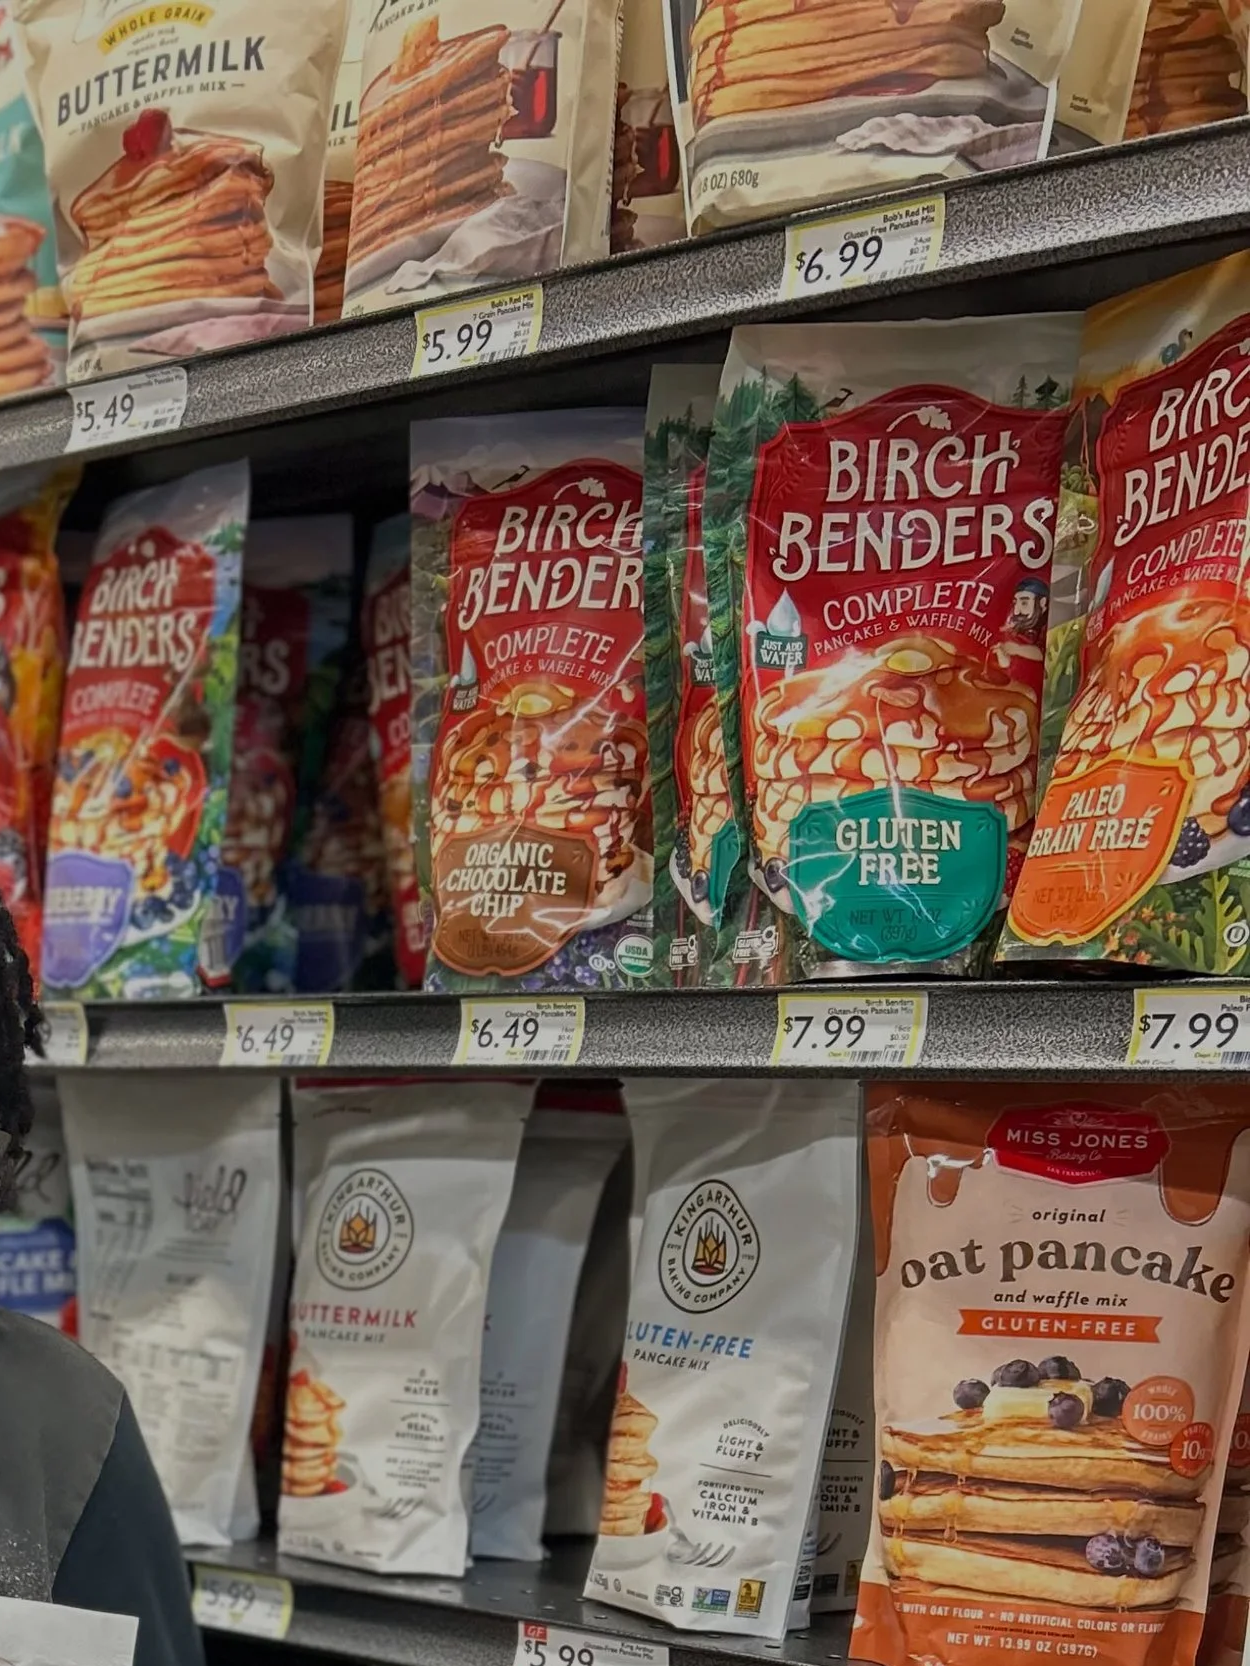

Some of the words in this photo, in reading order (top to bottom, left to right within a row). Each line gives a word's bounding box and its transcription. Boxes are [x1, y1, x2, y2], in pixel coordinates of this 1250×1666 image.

[104, 10, 156, 46] WHOLE
[164, 6, 205, 22] GRAIN
[57, 36, 266, 127] BUTTERMILK
[870, 225, 886, 235] Free
[920, 215, 934, 225] Mix
[883, 211, 901, 223] Bob's
[905, 208, 919, 218] Red
[795, 236, 883, 284] $6.99
[422, 320, 493, 363] $5.99
[76, 393, 134, 432] $5.49
[1150, 369, 1250, 452] BIRC
[827, 431, 1020, 501] BIRCH
[1114, 428, 1250, 546] BENDE
[770, 498, 1055, 580] BENDERS
[91, 560, 179, 614] BIRCH
[457, 556, 645, 630] BENDER
[823, 582, 994, 630] COMPLETE
[484, 625, 615, 668] COMPLETE
[761, 642, 782, 653] JUST
[785, 642, 803, 652] ADD
[814, 622, 884, 656] PANCAKE
[888, 619, 901, 632] &
[906, 613, 964, 630] WAFFLE
[969, 624, 992, 645] MIX
[759, 650, 804, 666] WATER
[1060, 784, 1126, 821] PALEO
[835, 819, 961, 851] GLUTEN
[1027, 828, 1089, 858] GRAIN
[1092, 815, 1155, 852] FREE
[465, 842, 554, 868] ORGANIC
[858, 853, 942, 885] FREE
[446, 868, 566, 895] CHOCOLATE
[470, 892, 523, 918] CHIP
[625, 945, 648, 956] USDA
[236, 1025, 294, 1054] $6.49
[471, 1018, 539, 1048] $6.49
[783, 1015, 865, 1048] $7.99
[1139, 1013, 1238, 1049] $7.99
[1007, 1128, 1061, 1146] MISS
[1070, 1133, 1148, 1149] JONES
[357, 1177, 405, 1224] ARTHUR
[1032, 1209, 1106, 1224] original
[674, 1195, 704, 1237] KING
[707, 1191, 752, 1246] ARTHUR
[668, 1258, 691, 1300] BAKING
[694, 1267, 745, 1303] COMPANY
[901, 1239, 985, 1289] oat
[1000, 1239, 1236, 1304] pancake
[994, 1291, 1026, 1303] and
[1033, 1291, 1089, 1307] waffle
[1096, 1295, 1128, 1307] mix
[626, 1324, 754, 1360] LUTEN-FREE
[981, 1316, 1136, 1336] GLUTEN-FREE
[634, 1349, 686, 1368] PANCAKE
[689, 1359, 709, 1371] MIX
[1133, 1404, 1186, 1421] 100%
[716, 1446, 762, 1462] FLUFFY
[718, 1435, 753, 1448] LIGHT
[756, 1442, 764, 1451] &
[700, 1490, 757, 1505] CALCIUM
[704, 1502, 737, 1513] IRON
[742, 1507, 749, 1515] &
[692, 1509, 746, 1524] VITAMIN
[902, 1603, 926, 1615] WITH
[930, 1606, 949, 1617] OAT
[953, 1608, 983, 1620] FLOUR
[527, 1625, 543, 1637] GF
[947, 1633, 969, 1645] NET
[999, 1635, 1032, 1651] 13.99
[1037, 1640, 1052, 1652] OZ
[1056, 1642, 1098, 1658] (397G)
